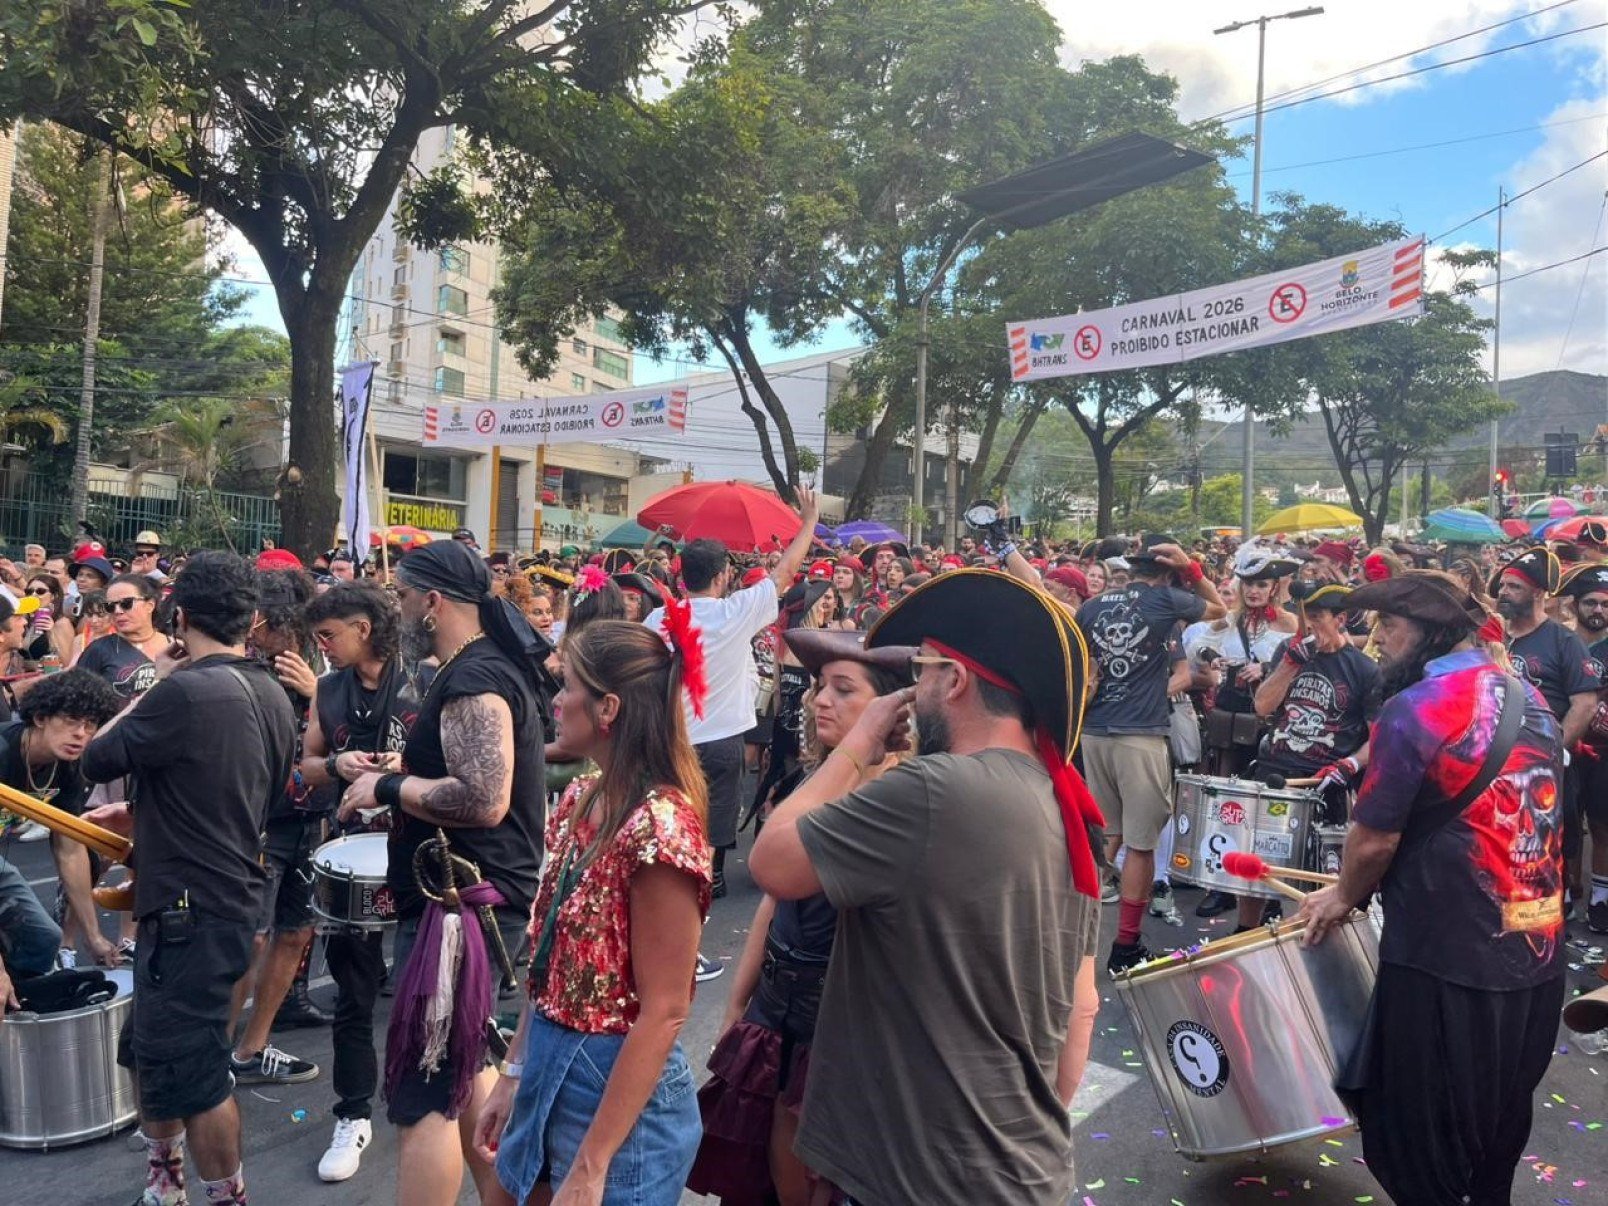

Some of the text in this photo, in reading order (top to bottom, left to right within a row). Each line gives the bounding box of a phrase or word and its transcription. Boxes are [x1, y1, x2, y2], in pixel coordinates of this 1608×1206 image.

[1321, 292, 1379, 311] HORIZONTE
[1121, 297, 1245, 333] CARNAVAL 2026
[1111, 315, 1260, 356] PROIBIDO ESTACIONAR
[1031, 354, 1068, 368] BHTRANS
[383, 503, 459, 530] VETERINÁRIA
[1289, 687, 1331, 710] INSANOS
[1296, 677, 1333, 698] PIRATAS
[362, 890, 373, 914] BLOCO
